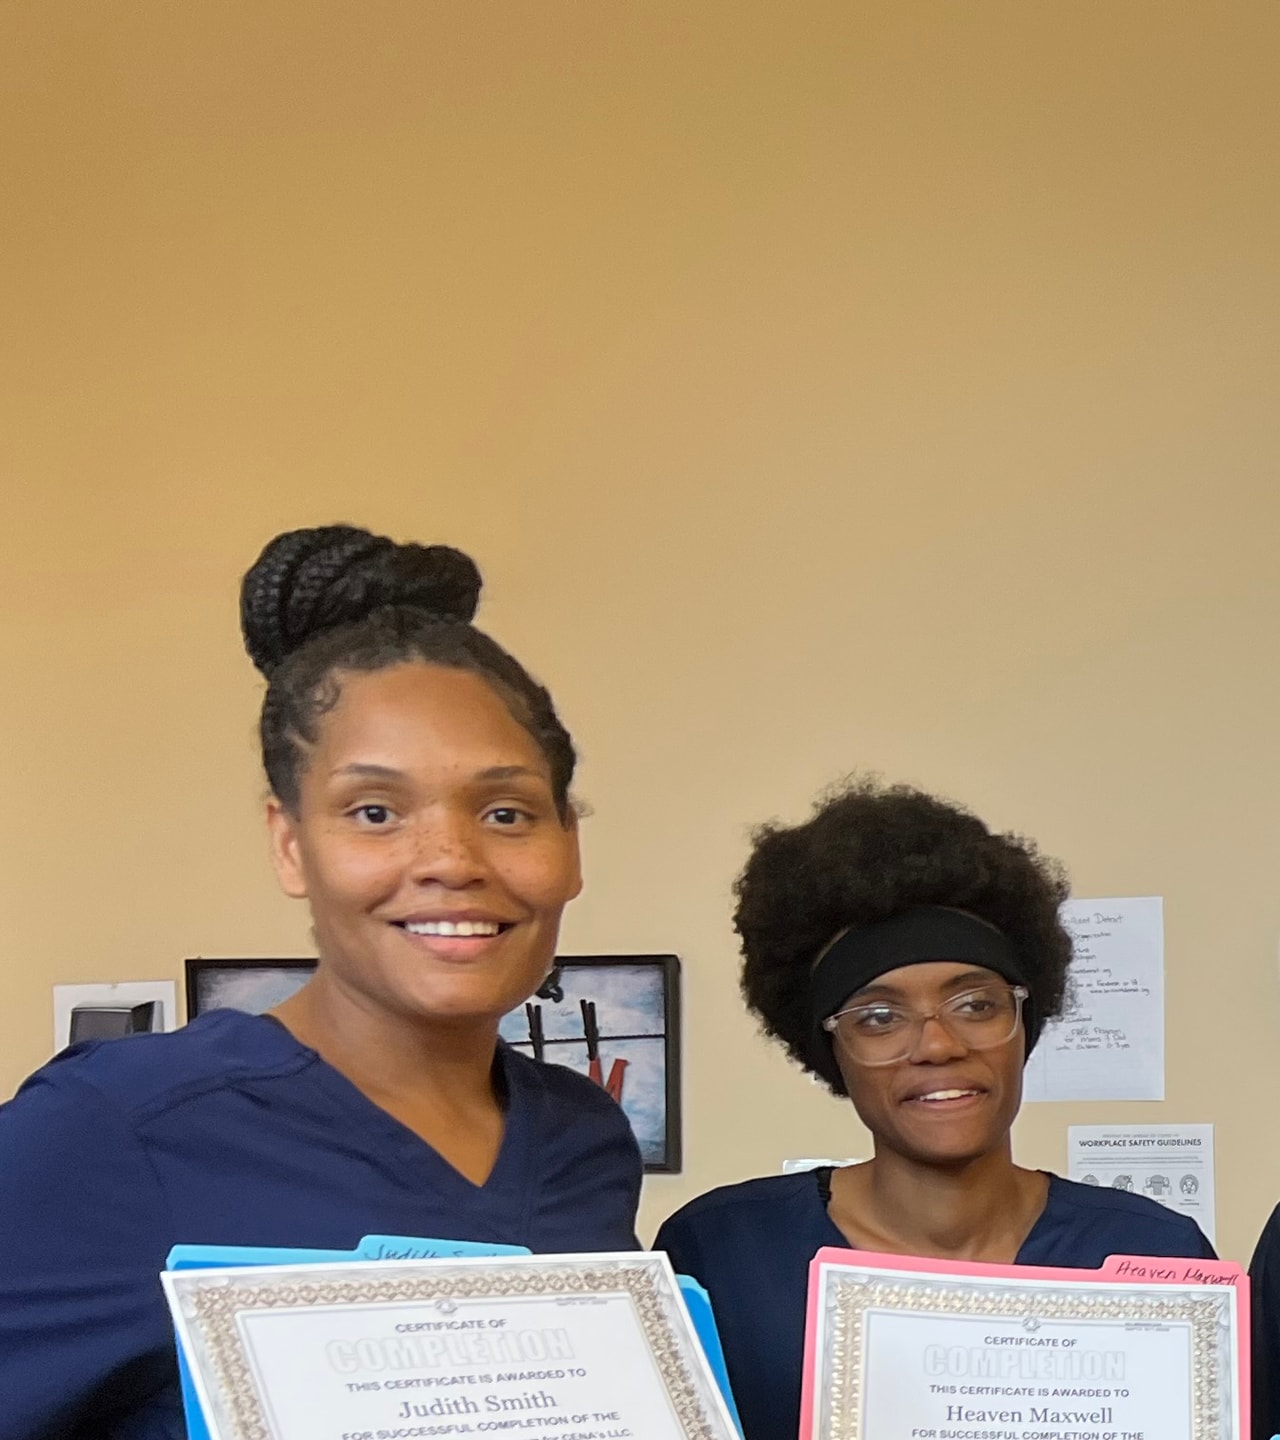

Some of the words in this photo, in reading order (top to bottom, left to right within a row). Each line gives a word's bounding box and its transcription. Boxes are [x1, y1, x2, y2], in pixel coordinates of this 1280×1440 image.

[1129, 1139, 1156, 1147] SAFETY
[1157, 1138, 1202, 1146] GUIDELINES
[1116, 1260, 1177, 1279] Heaven
[394, 1319, 486, 1333] CERTIFICATE
[488, 1318, 506, 1328] OF
[984, 1335, 1059, 1347] CERTIFICATE
[1061, 1338, 1077, 1348] OF
[326, 1328, 575, 1374] COMPLETION
[924, 1344, 1125, 1381] COMPLETION
[929, 1384, 957, 1394] THIS
[959, 1385, 1035, 1397] CERTIFICATE
[1037, 1387, 1049, 1397] IS
[1051, 1388, 1111, 1397] AWARDED
[1113, 1388, 1129, 1398] TO
[398, 1395, 480, 1419] Judith
[484, 1390, 558, 1412] Smith
[946, 1405, 1022, 1422] Heaven
[1028, 1407, 1112, 1424] Maxwell
[911, 1428, 937, 1438] FOR
[939, 1429, 1019, 1440] SUCCESSFUL
[1021, 1431, 1100, 1440] COMPLETION
[1102, 1431, 1118, 1440] OF
[1120, 1431, 1144, 1440] THE
